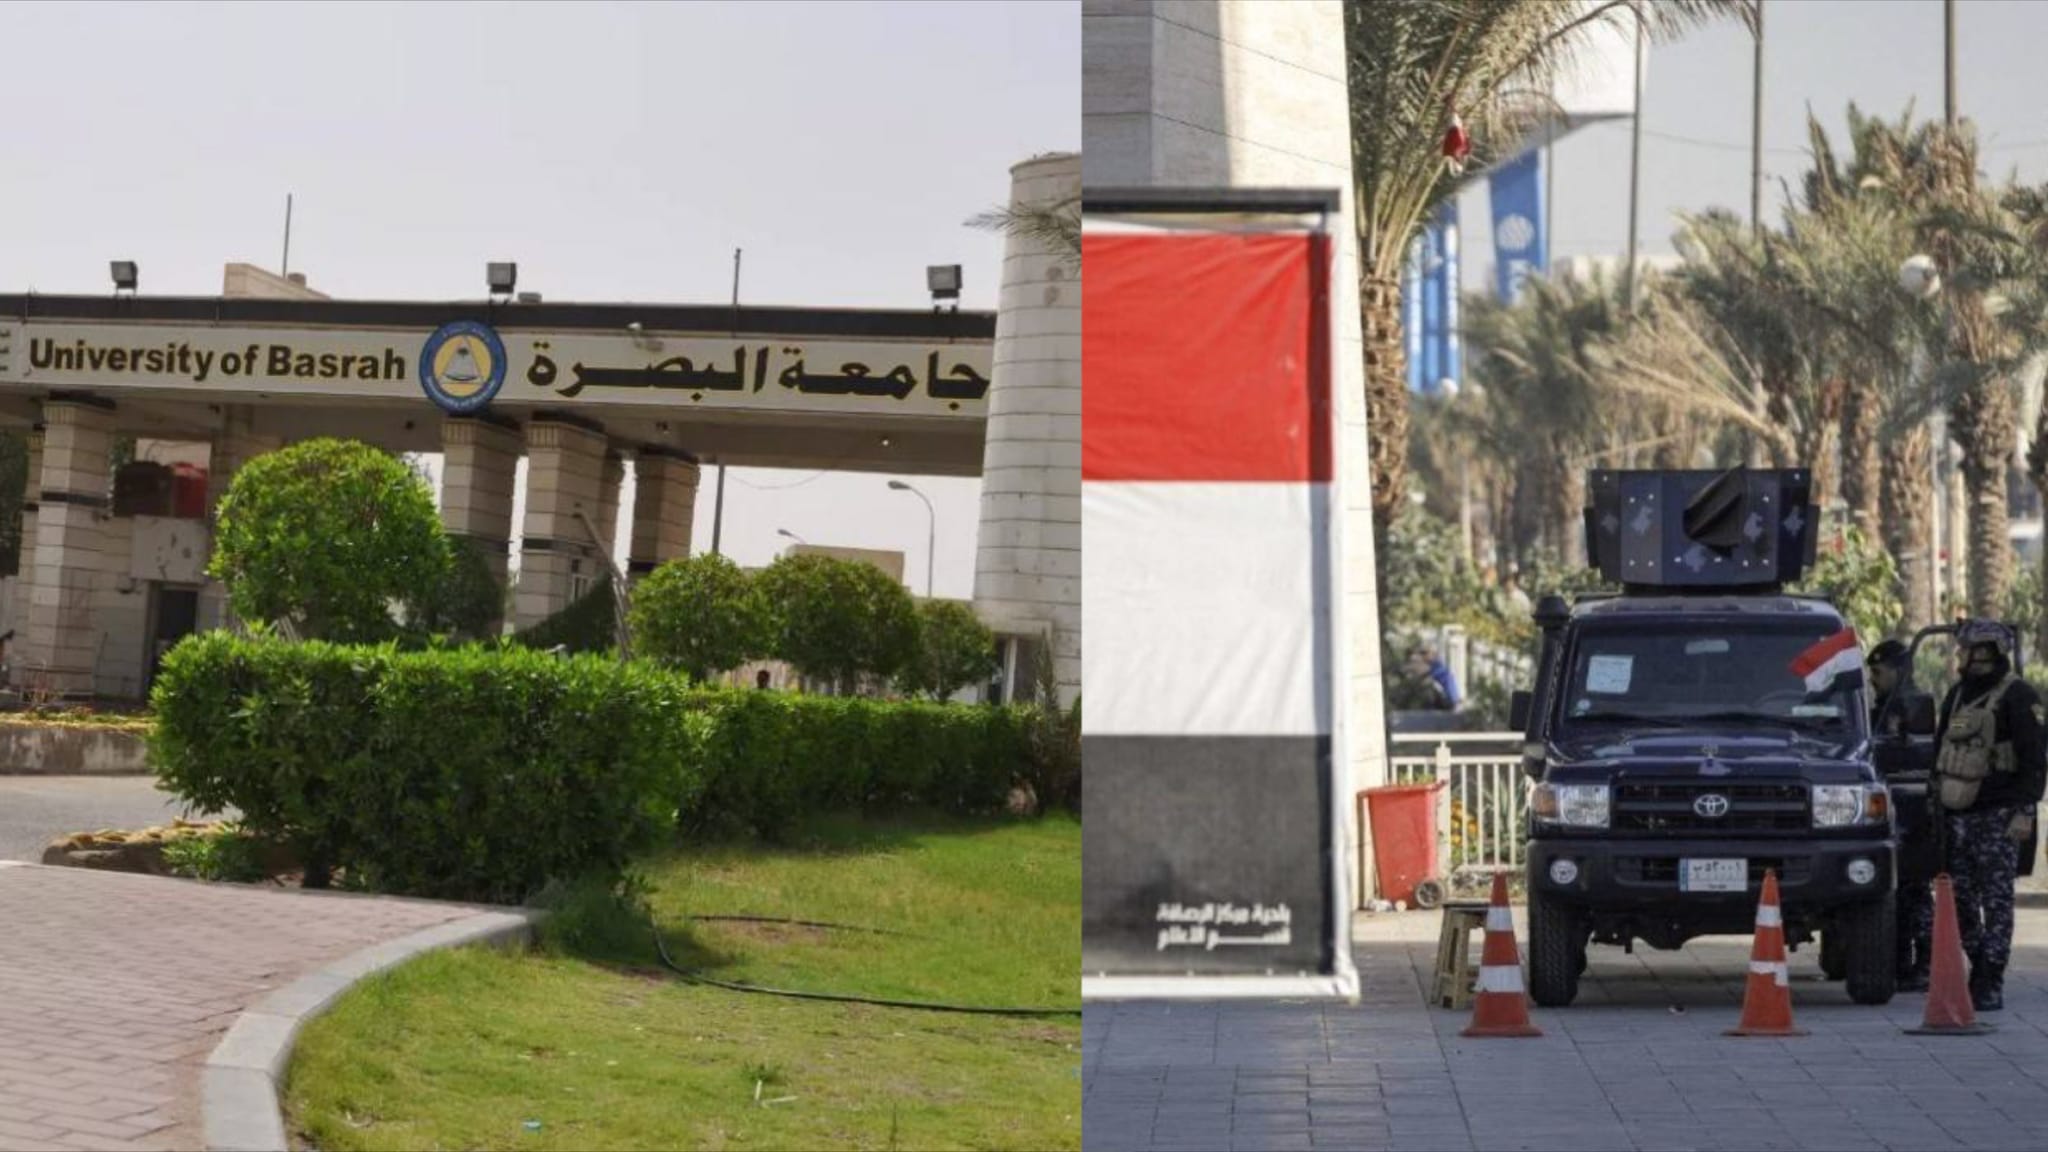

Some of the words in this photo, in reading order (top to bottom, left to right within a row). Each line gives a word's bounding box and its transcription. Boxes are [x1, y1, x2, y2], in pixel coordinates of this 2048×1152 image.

[29, 338, 214, 382] University
[219, 343, 260, 376] of
[266, 346, 406, 380] Basrah
[526, 340, 770, 403] البصرة
[778, 346, 991, 412] جامعة
